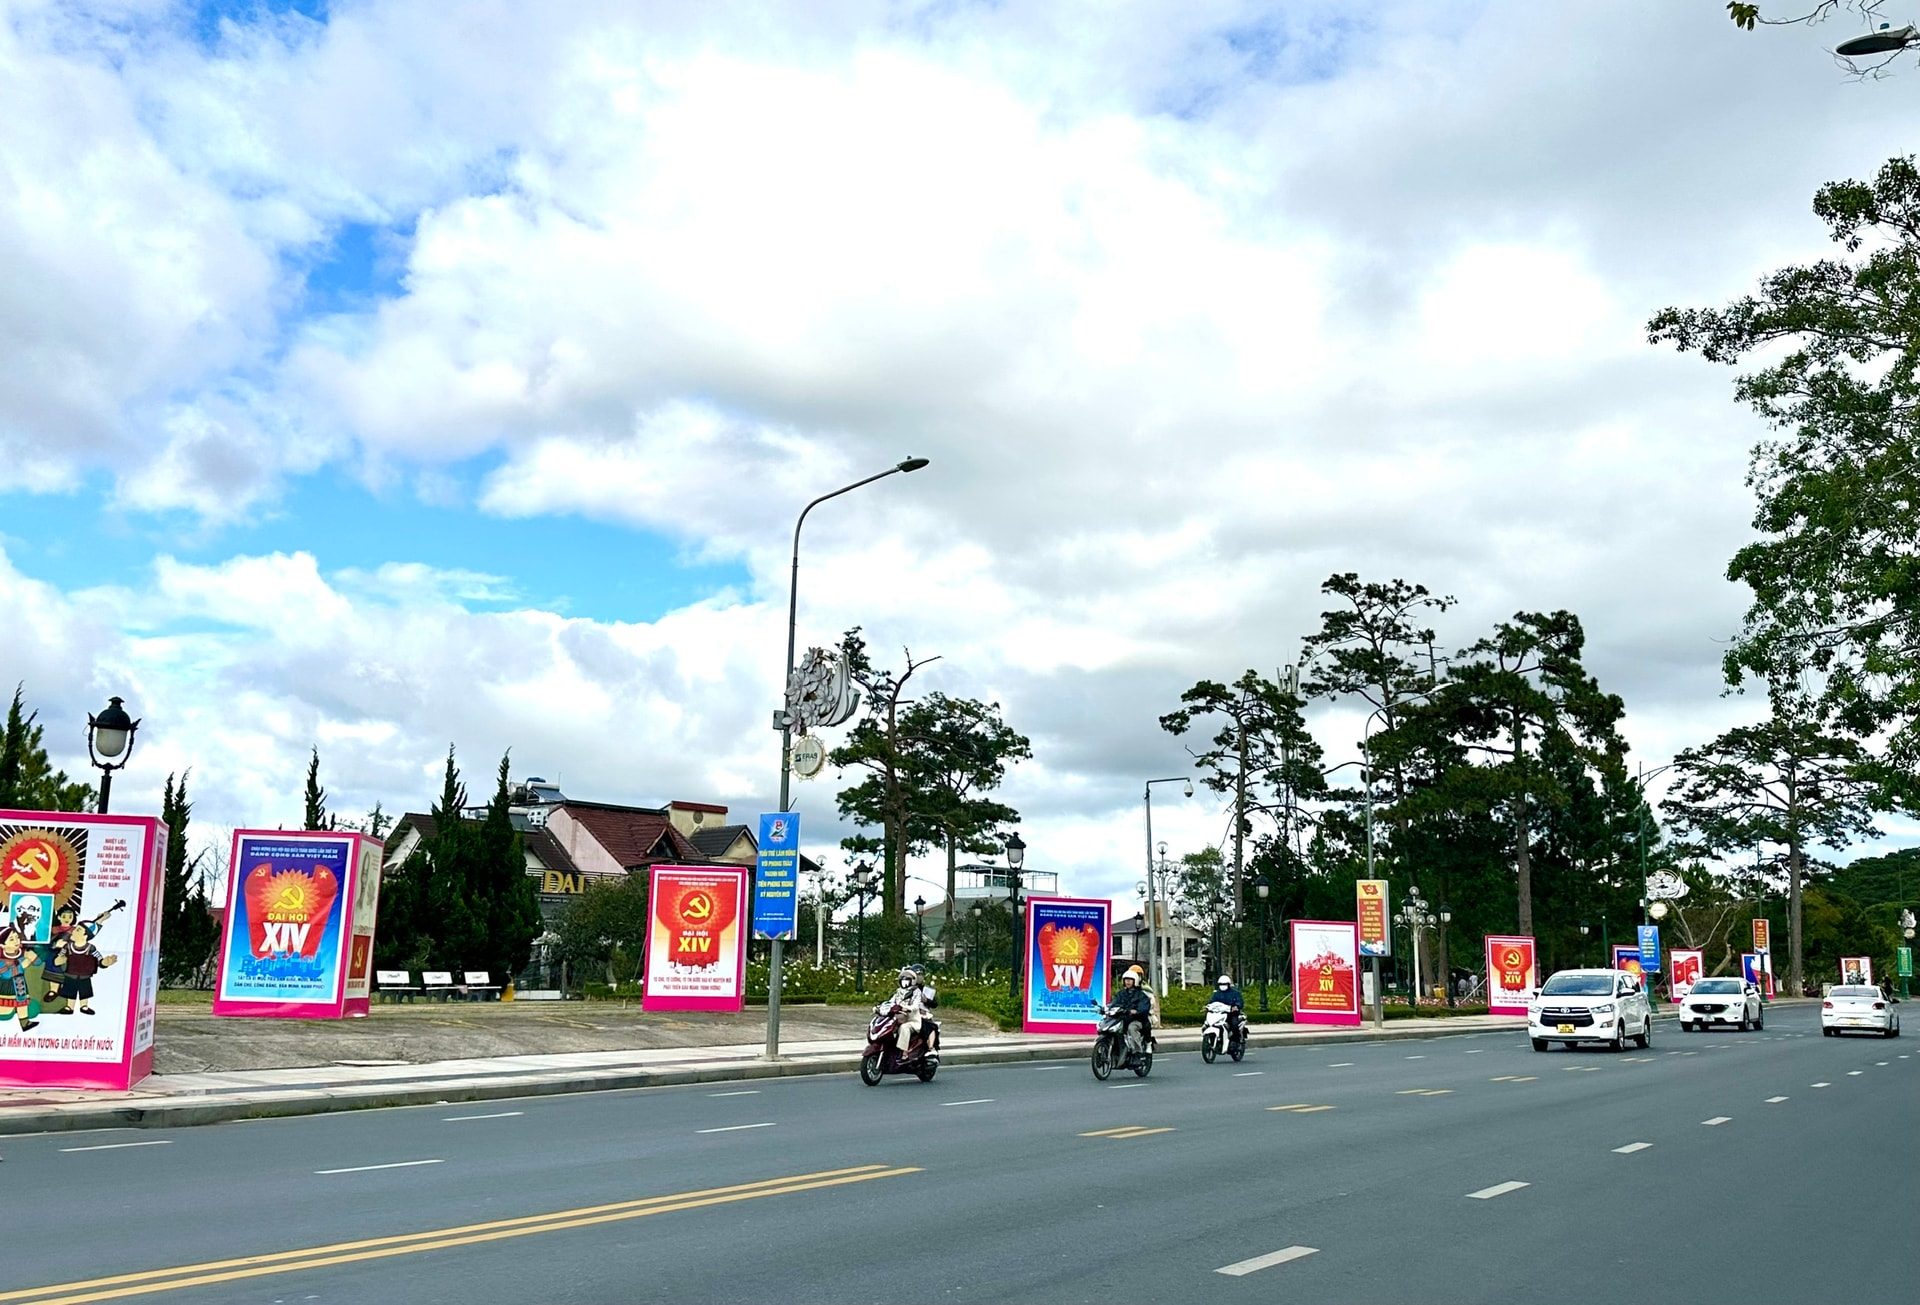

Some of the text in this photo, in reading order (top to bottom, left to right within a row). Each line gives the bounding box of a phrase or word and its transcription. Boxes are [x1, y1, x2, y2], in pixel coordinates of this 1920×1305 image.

[258, 921, 312, 953] XIV
[678, 936, 712, 953] XIV
[1051, 964, 1085, 987] XIV
[1505, 975, 1521, 984] XIV
[1319, 979, 1334, 991] XIV
[23, 1037, 36, 1048] NON
[61, 1038, 71, 1050] LAI
